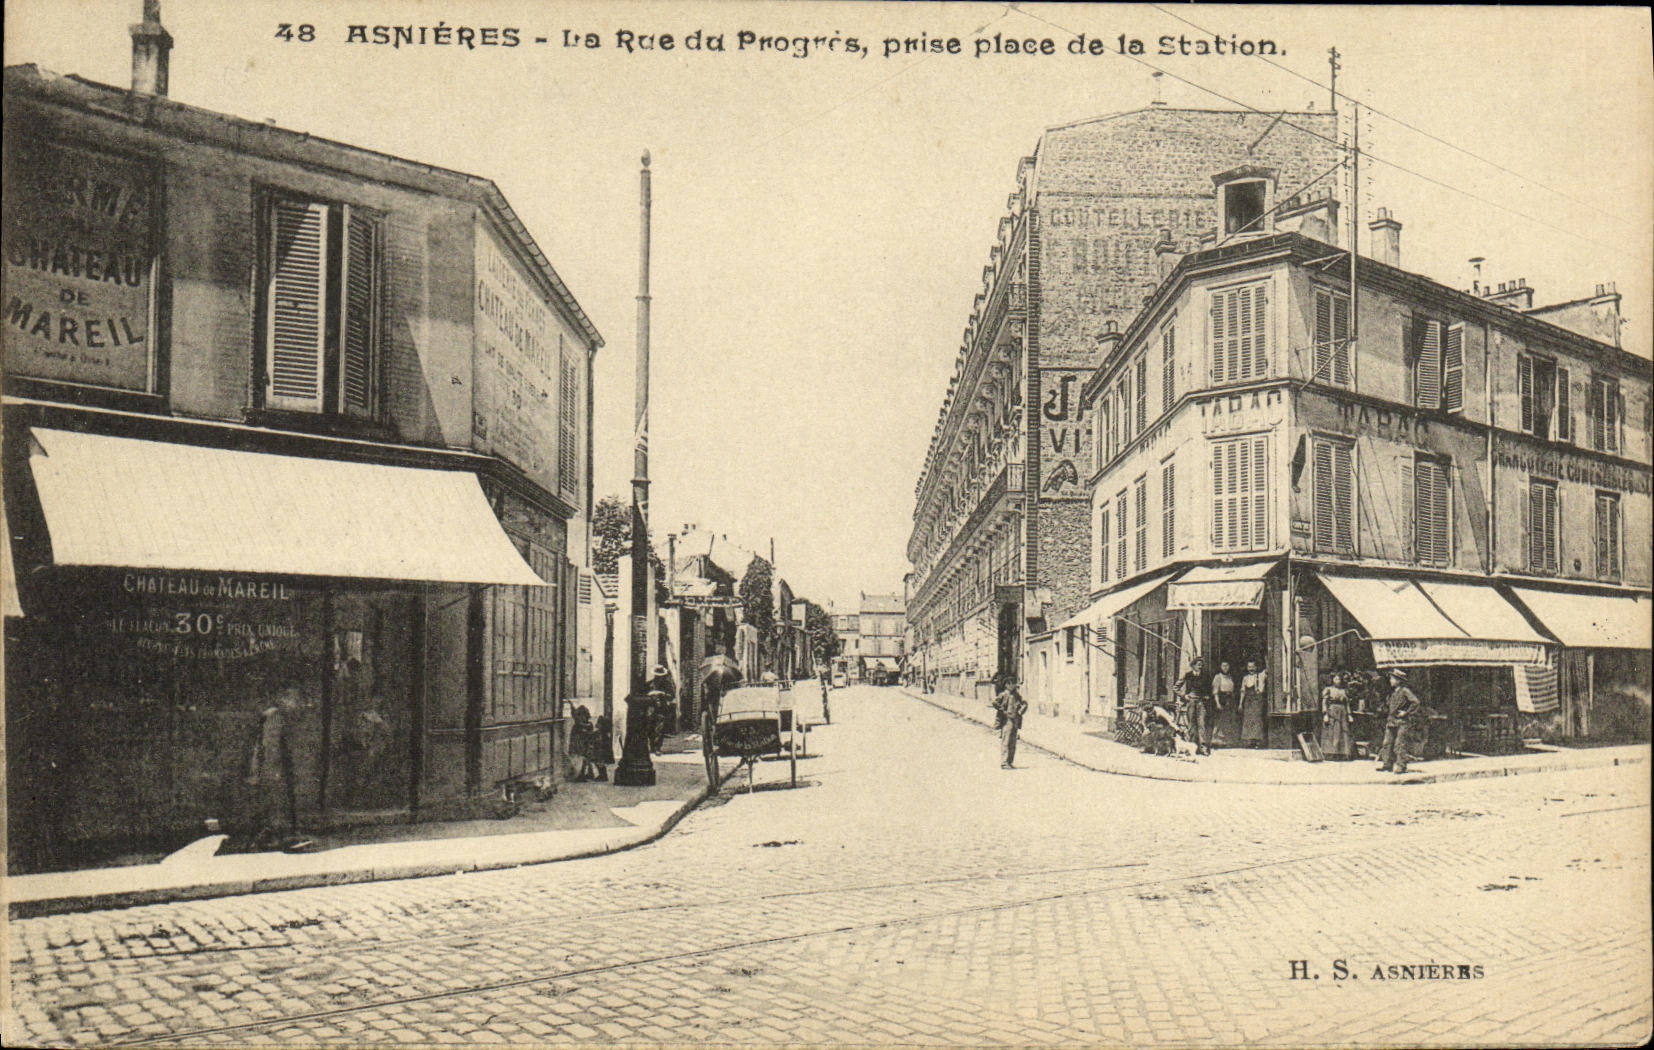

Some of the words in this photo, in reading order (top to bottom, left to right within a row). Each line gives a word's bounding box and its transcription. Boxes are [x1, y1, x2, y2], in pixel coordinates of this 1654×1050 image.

[60, 288, 91, 307] DE
[4, 296, 144, 348] MAREIL
[123, 574, 200, 596] CHATEAU
[218, 576, 290, 600] MAREIL
